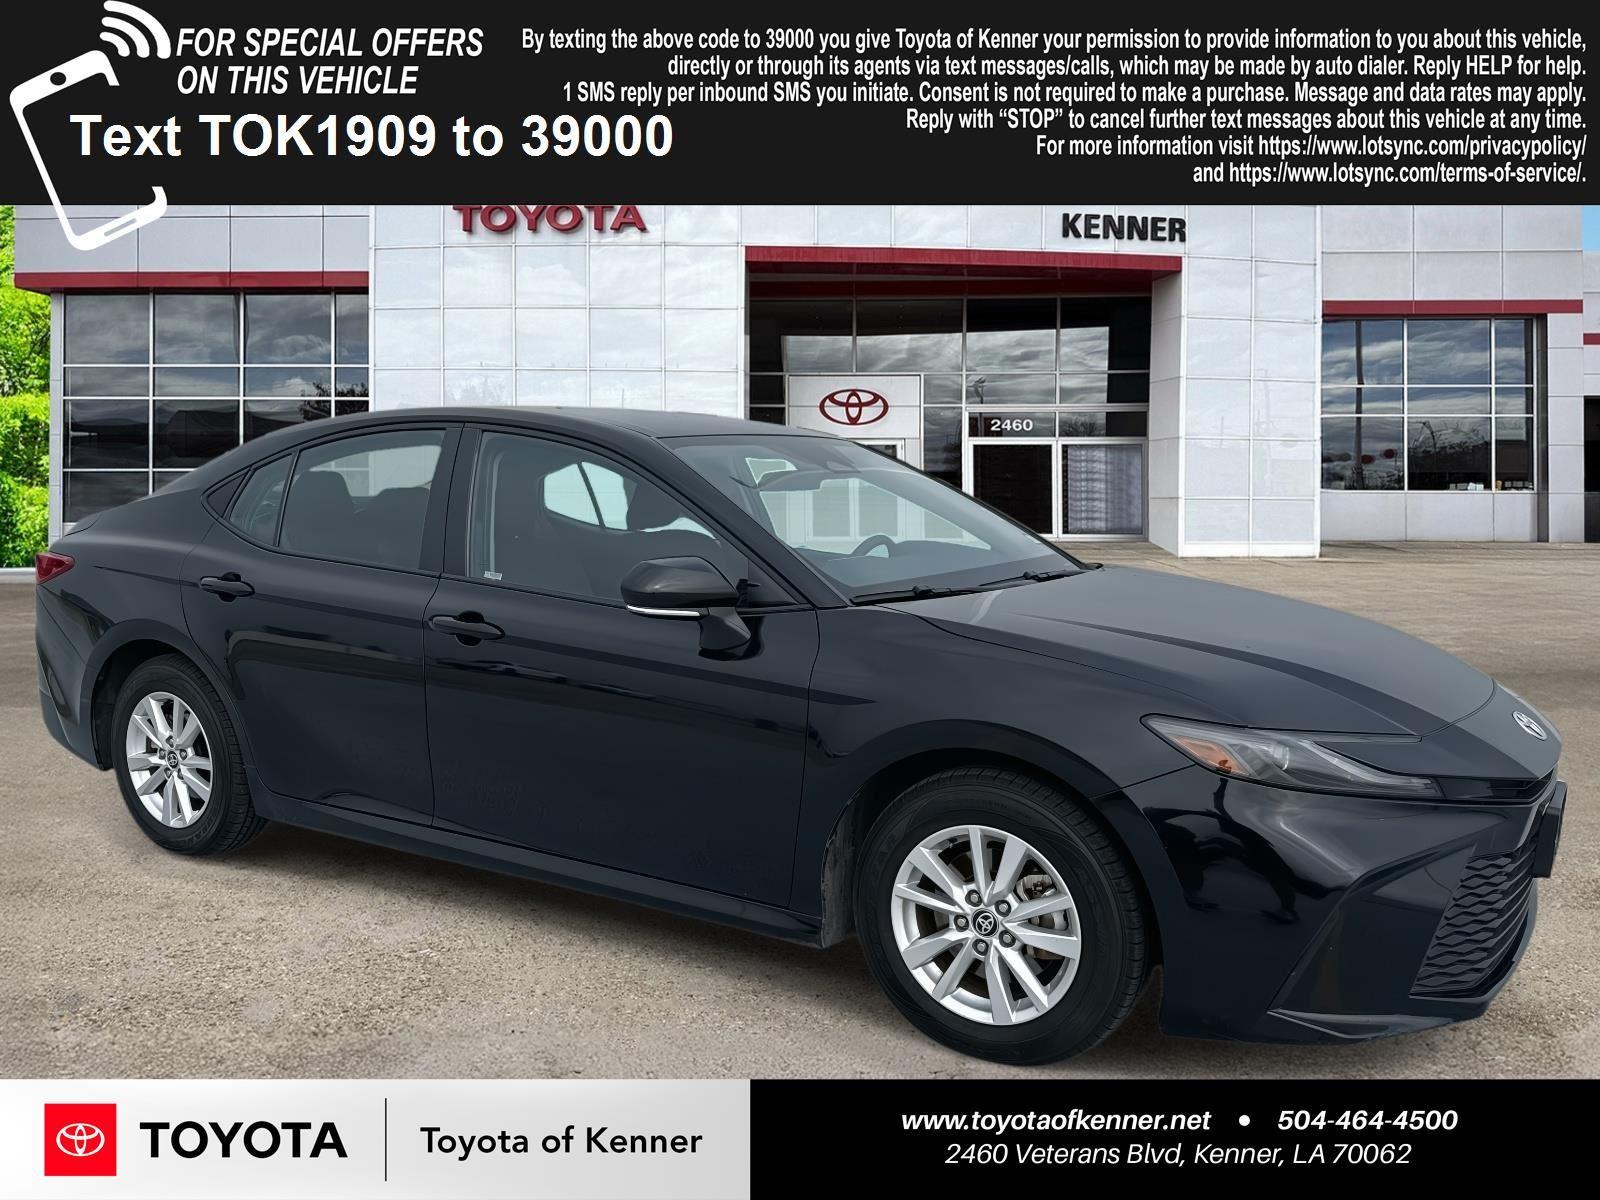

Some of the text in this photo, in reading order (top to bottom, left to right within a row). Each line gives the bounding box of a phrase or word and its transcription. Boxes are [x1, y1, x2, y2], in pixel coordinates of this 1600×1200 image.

[453, 205, 647, 232] TOYOTA
[1063, 213, 1186, 242] KENNER
[991, 419, 1033, 431] 2460
